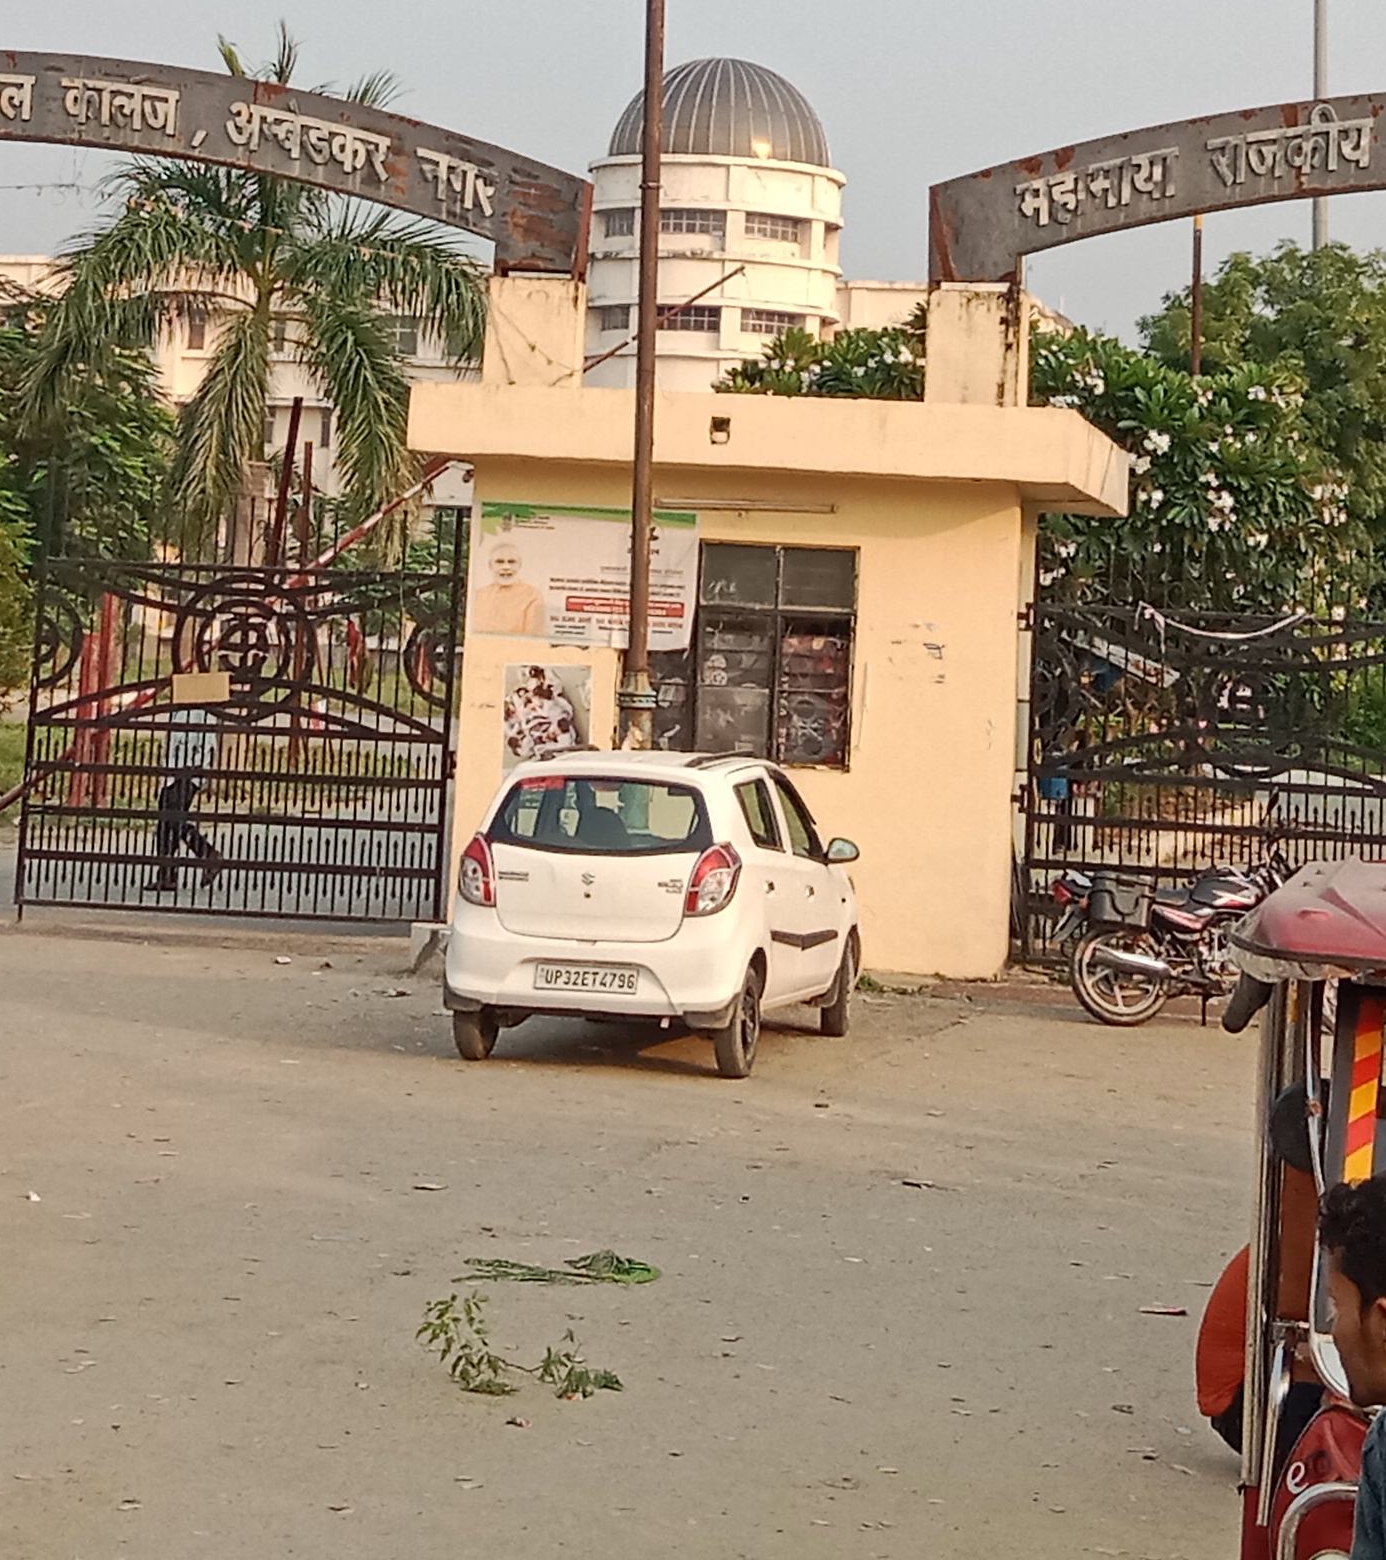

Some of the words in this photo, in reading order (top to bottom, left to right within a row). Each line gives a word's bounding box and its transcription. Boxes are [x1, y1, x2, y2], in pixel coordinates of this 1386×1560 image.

[415, 146, 499, 217] नगर
[1015, 146, 1180, 227] महामाया
[1206, 103, 1375, 187] राजकीय
[544, 968, 635, 990] UP32ET4796
